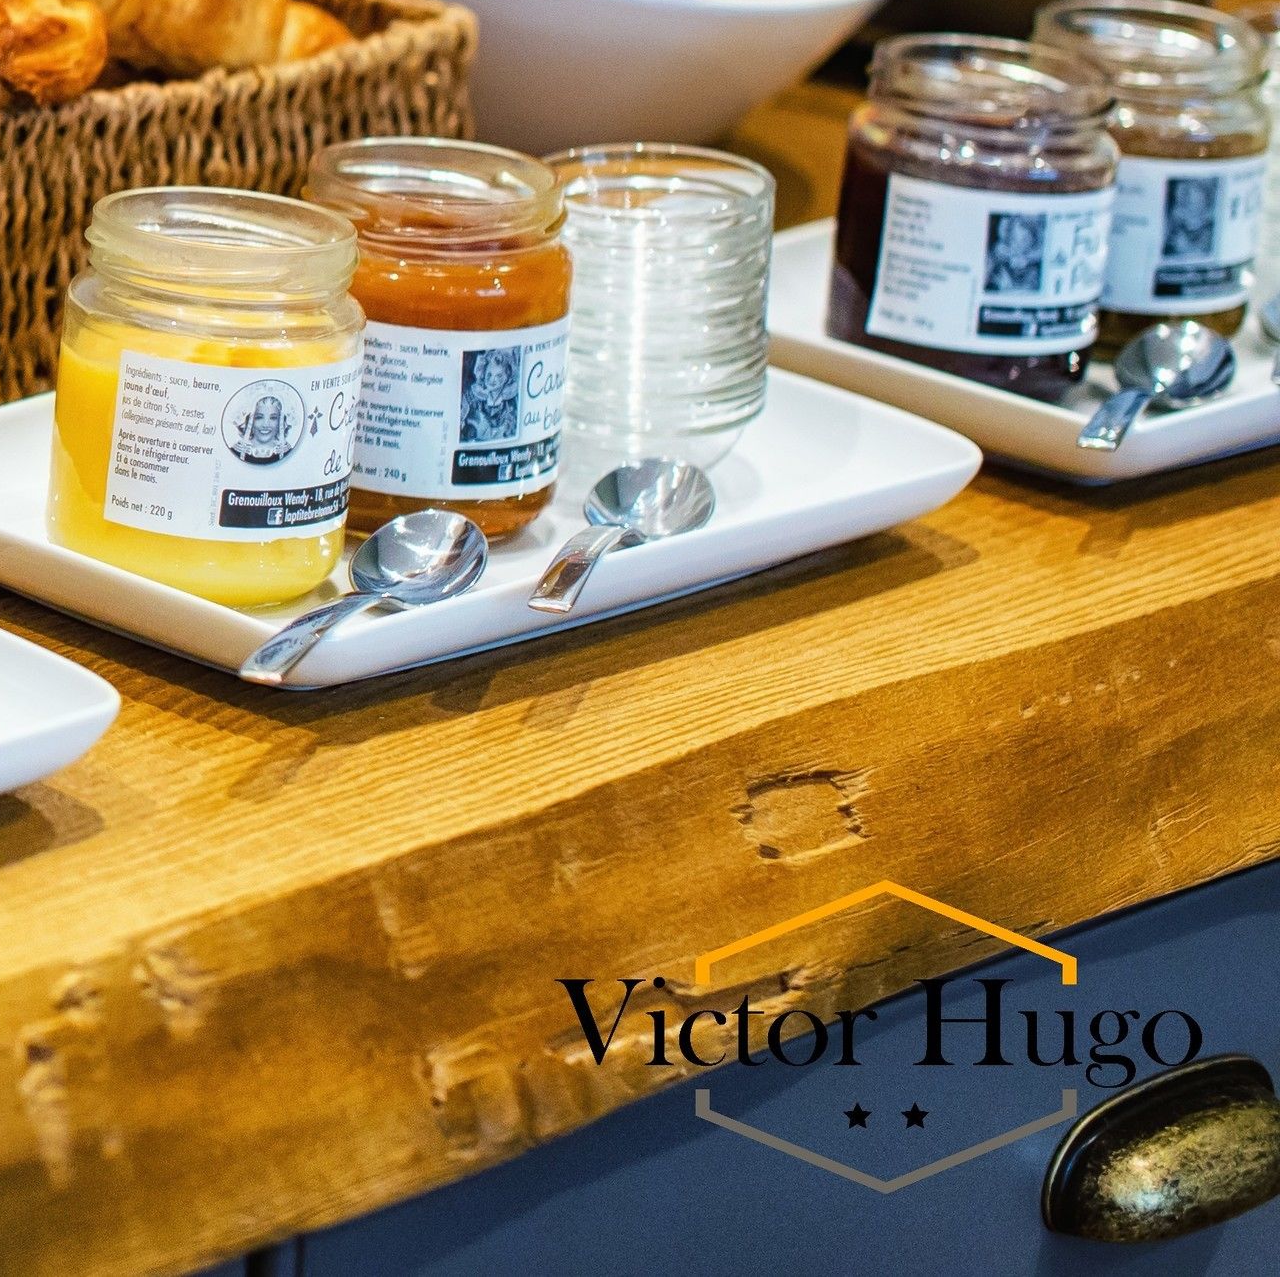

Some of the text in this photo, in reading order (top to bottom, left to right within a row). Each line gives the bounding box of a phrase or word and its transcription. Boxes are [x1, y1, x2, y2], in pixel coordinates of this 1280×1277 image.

[423, 344, 450, 358] beurre,
[123, 379, 143, 394] jaune
[125, 364, 162, 383] Ingrédients
[169, 376, 191, 389] sucre,
[193, 377, 222, 393] beurre,
[311, 381, 321, 392] EN
[323, 376, 341, 390] VENTE
[122, 395, 206, 420] jus de citron 5%, zestes
[370, 402, 403, 414] ouverture
[411, 409, 444, 419] conserver
[121, 409, 154, 426] (allergènes
[155, 418, 184, 432] présents
[202, 424, 217, 437] lait)
[118, 429, 214, 456] Après ouverture à conserver
[376, 436, 381, 447] 8
[116, 452, 170, 474] Et à consommer
[117, 441, 190, 465] dans le réfrigérateur.
[115, 464, 158, 484] dans le mois.
[384, 467, 401, 479] 240
[402, 473, 407, 483] g
[111, 494, 130, 510] Poids
[131, 502, 143, 513] net
[150, 504, 166, 517] 220
[167, 511, 173, 521] g
[228, 492, 283, 507] Grenouilloux
[285, 490, 310, 507] Wendy
